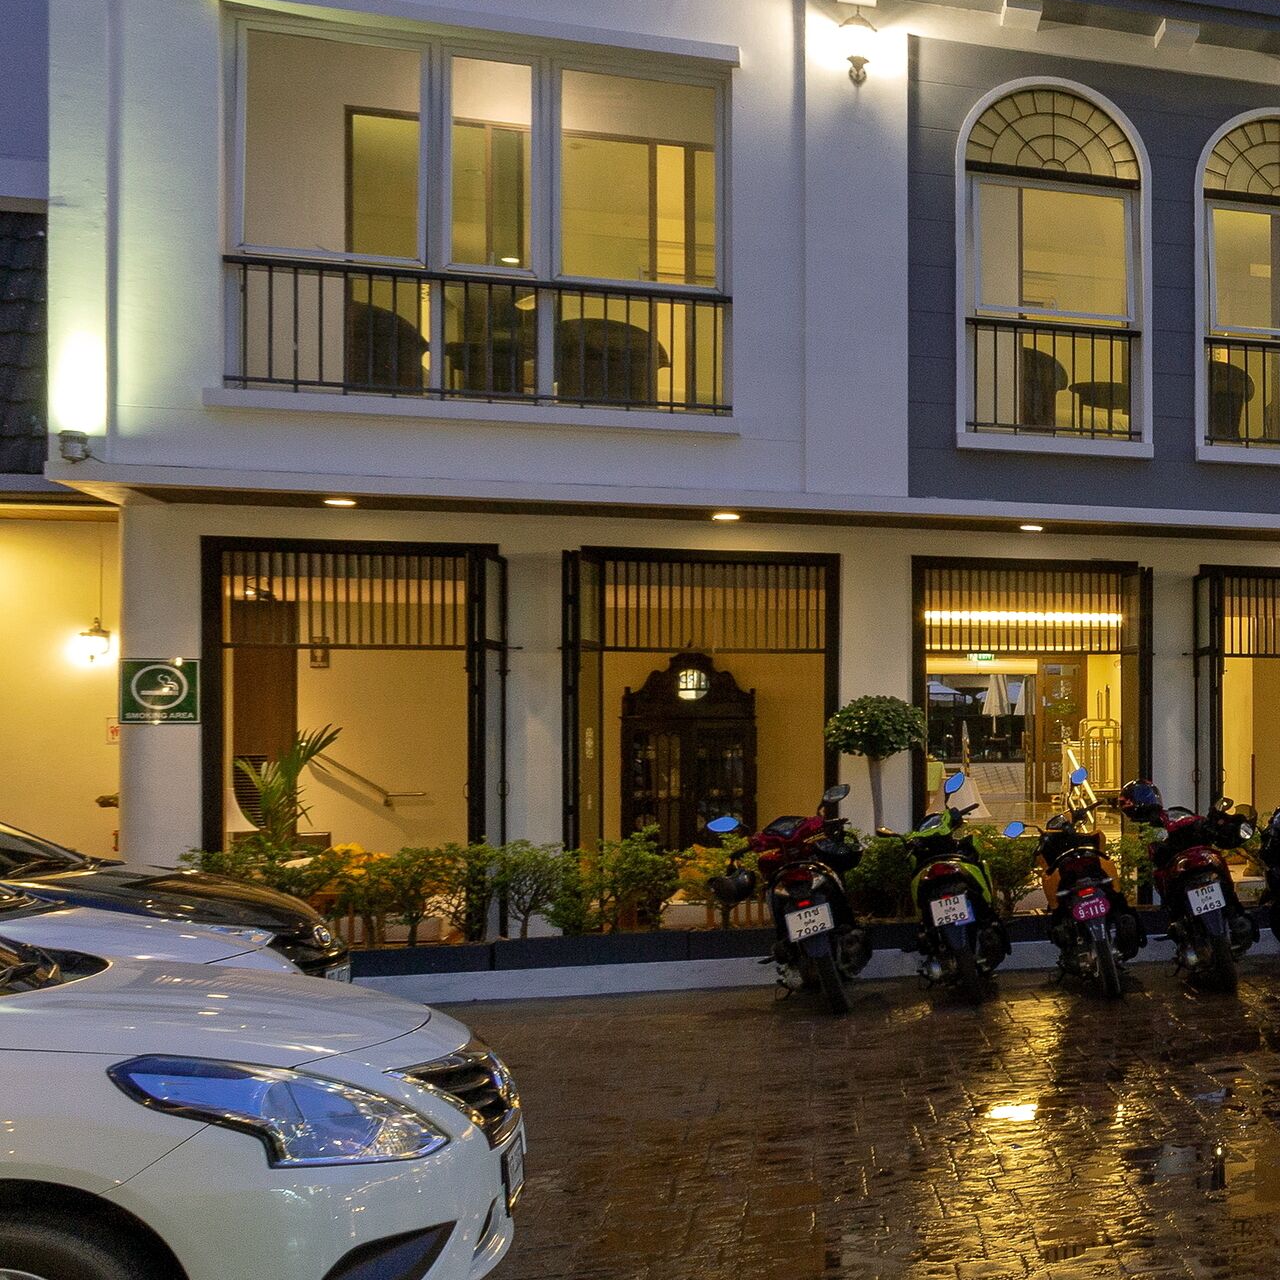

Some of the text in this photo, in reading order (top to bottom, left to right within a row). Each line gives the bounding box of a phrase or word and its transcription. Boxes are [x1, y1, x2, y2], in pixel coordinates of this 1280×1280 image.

[1195, 899, 1222, 914] 9463
[937, 911, 966, 925] 2536
[795, 922, 827, 937] 7002
